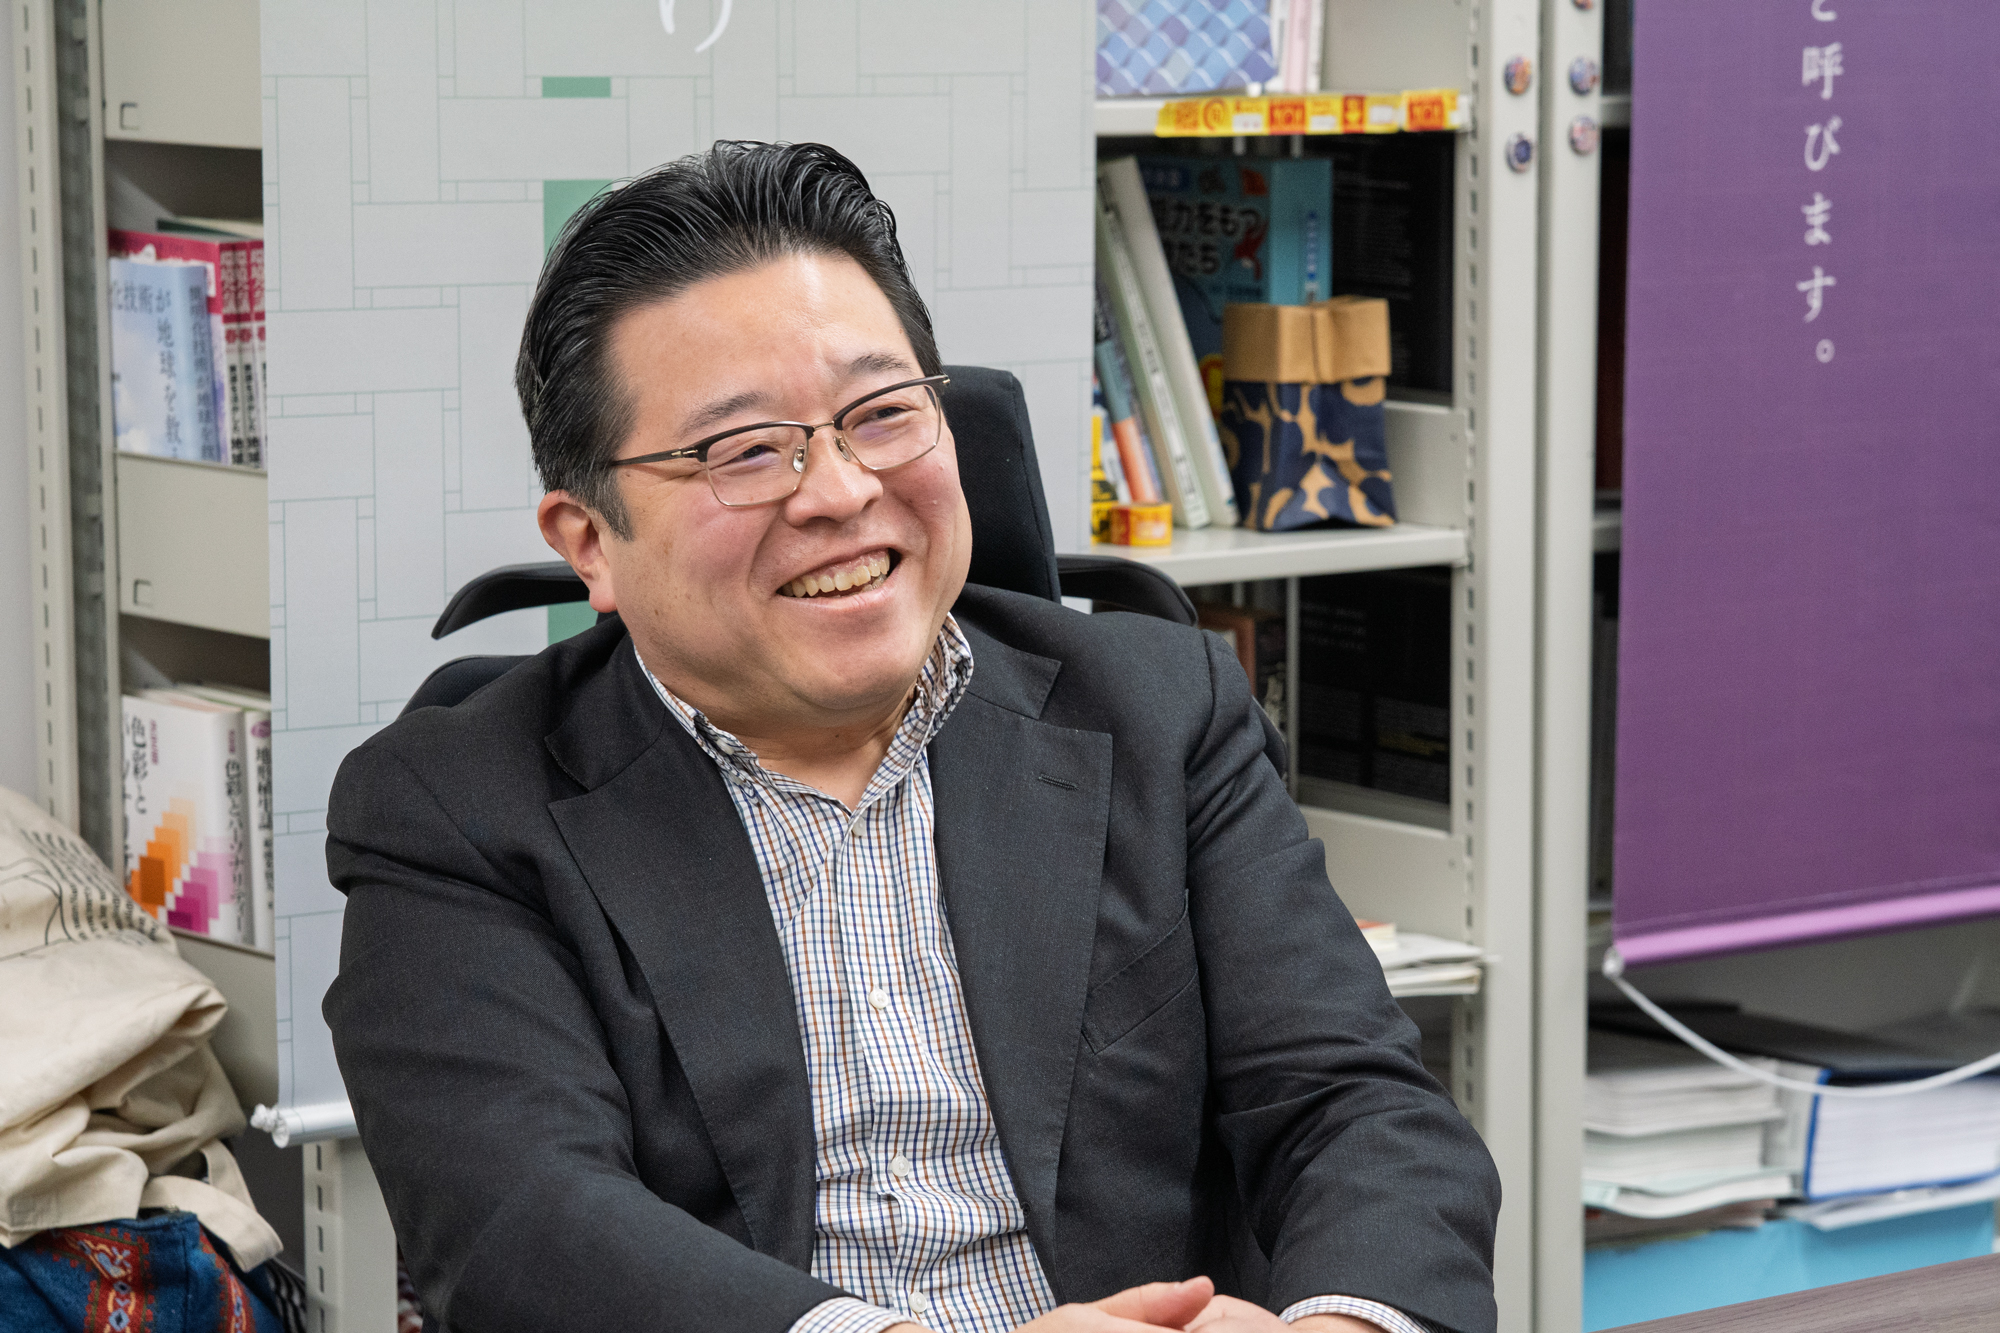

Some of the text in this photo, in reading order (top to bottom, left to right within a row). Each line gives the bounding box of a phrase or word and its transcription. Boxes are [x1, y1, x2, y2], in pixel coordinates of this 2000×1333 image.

[1796, 0, 1844, 364] と呼びます。
